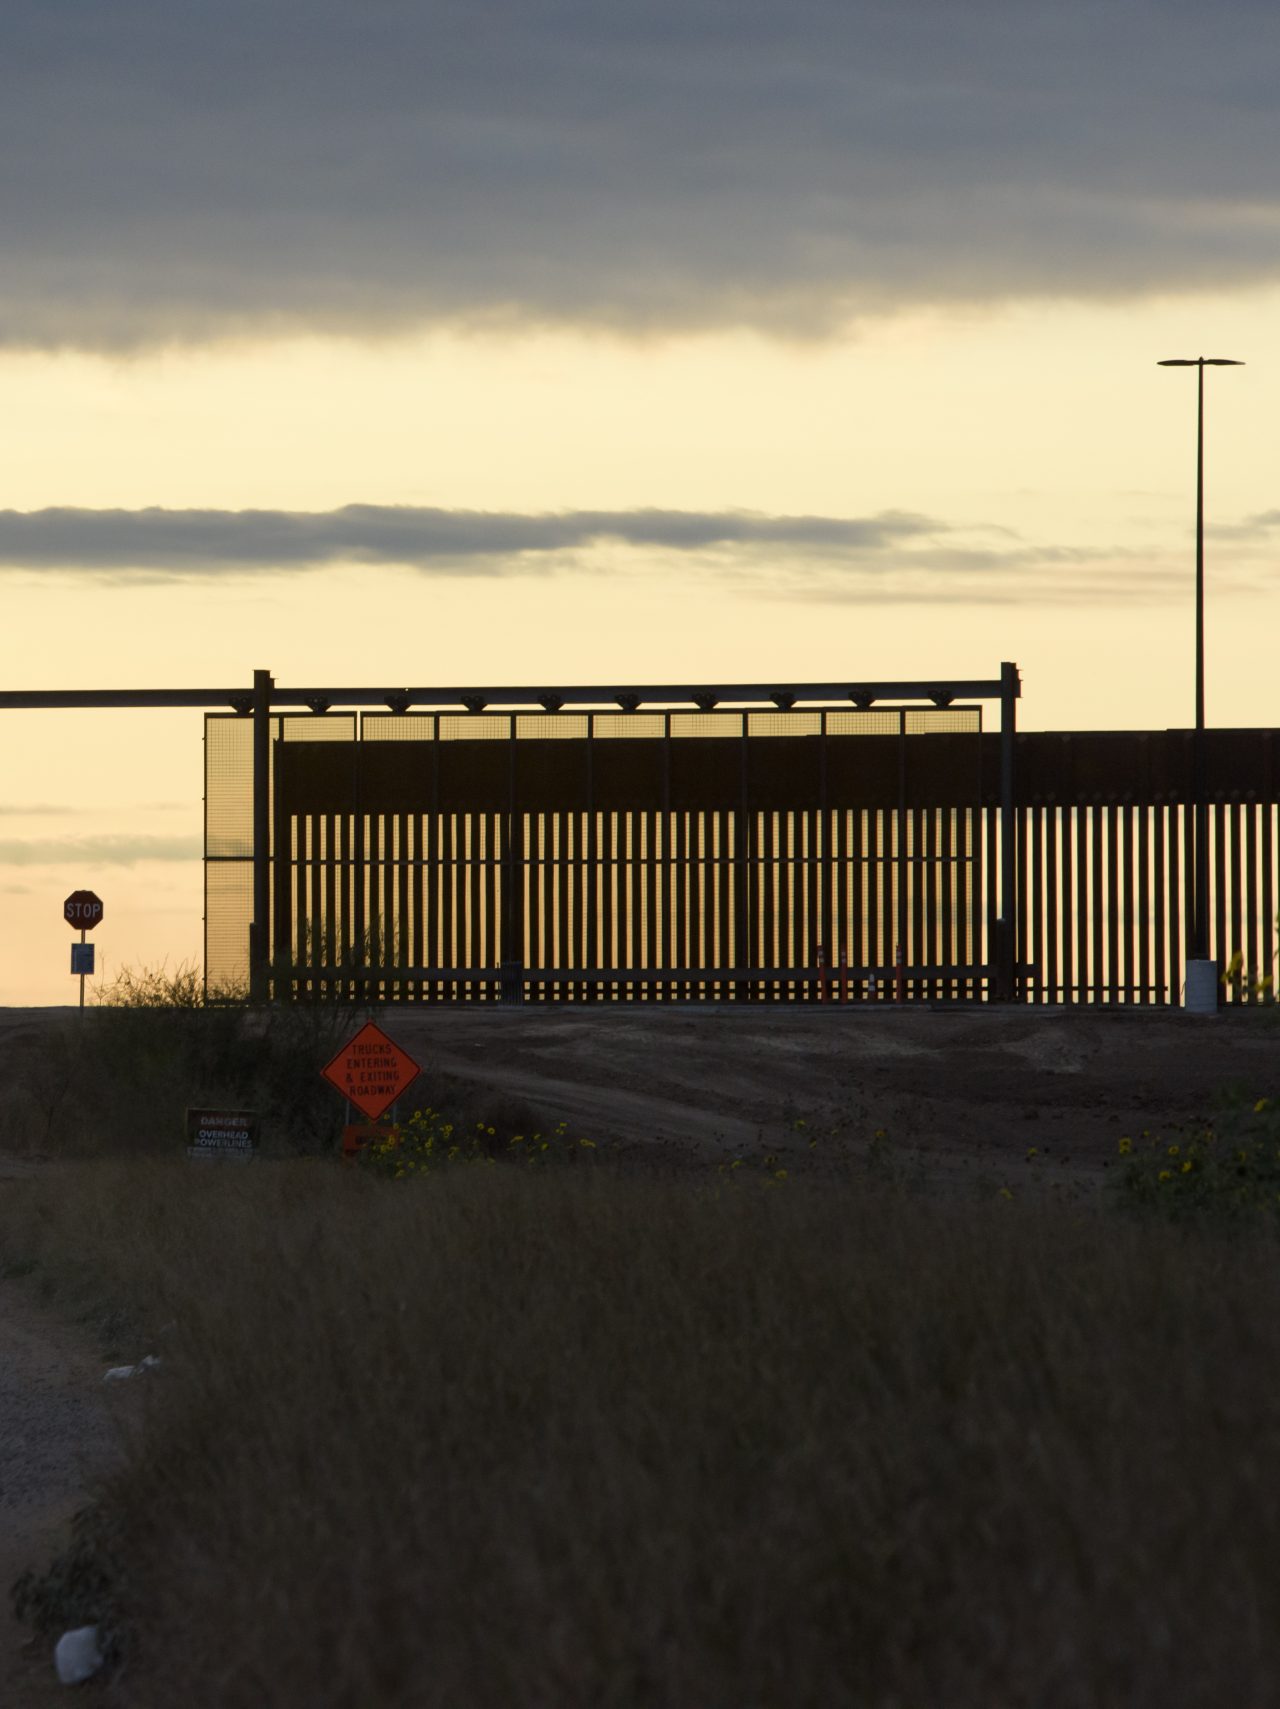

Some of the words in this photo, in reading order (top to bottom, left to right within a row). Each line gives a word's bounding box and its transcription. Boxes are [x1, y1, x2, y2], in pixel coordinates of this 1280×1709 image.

[66, 903, 101, 918] STOP
[352, 1044, 392, 1055] TRUCKS
[347, 1058, 397, 1069] ENTERING
[345, 1073, 353, 1083] &
[360, 1071, 400, 1082] EXITING
[349, 1085, 396, 1096] ROADWAY
[200, 1116, 247, 1126] DANGER
[199, 1129, 249, 1139] OVERHEAD
